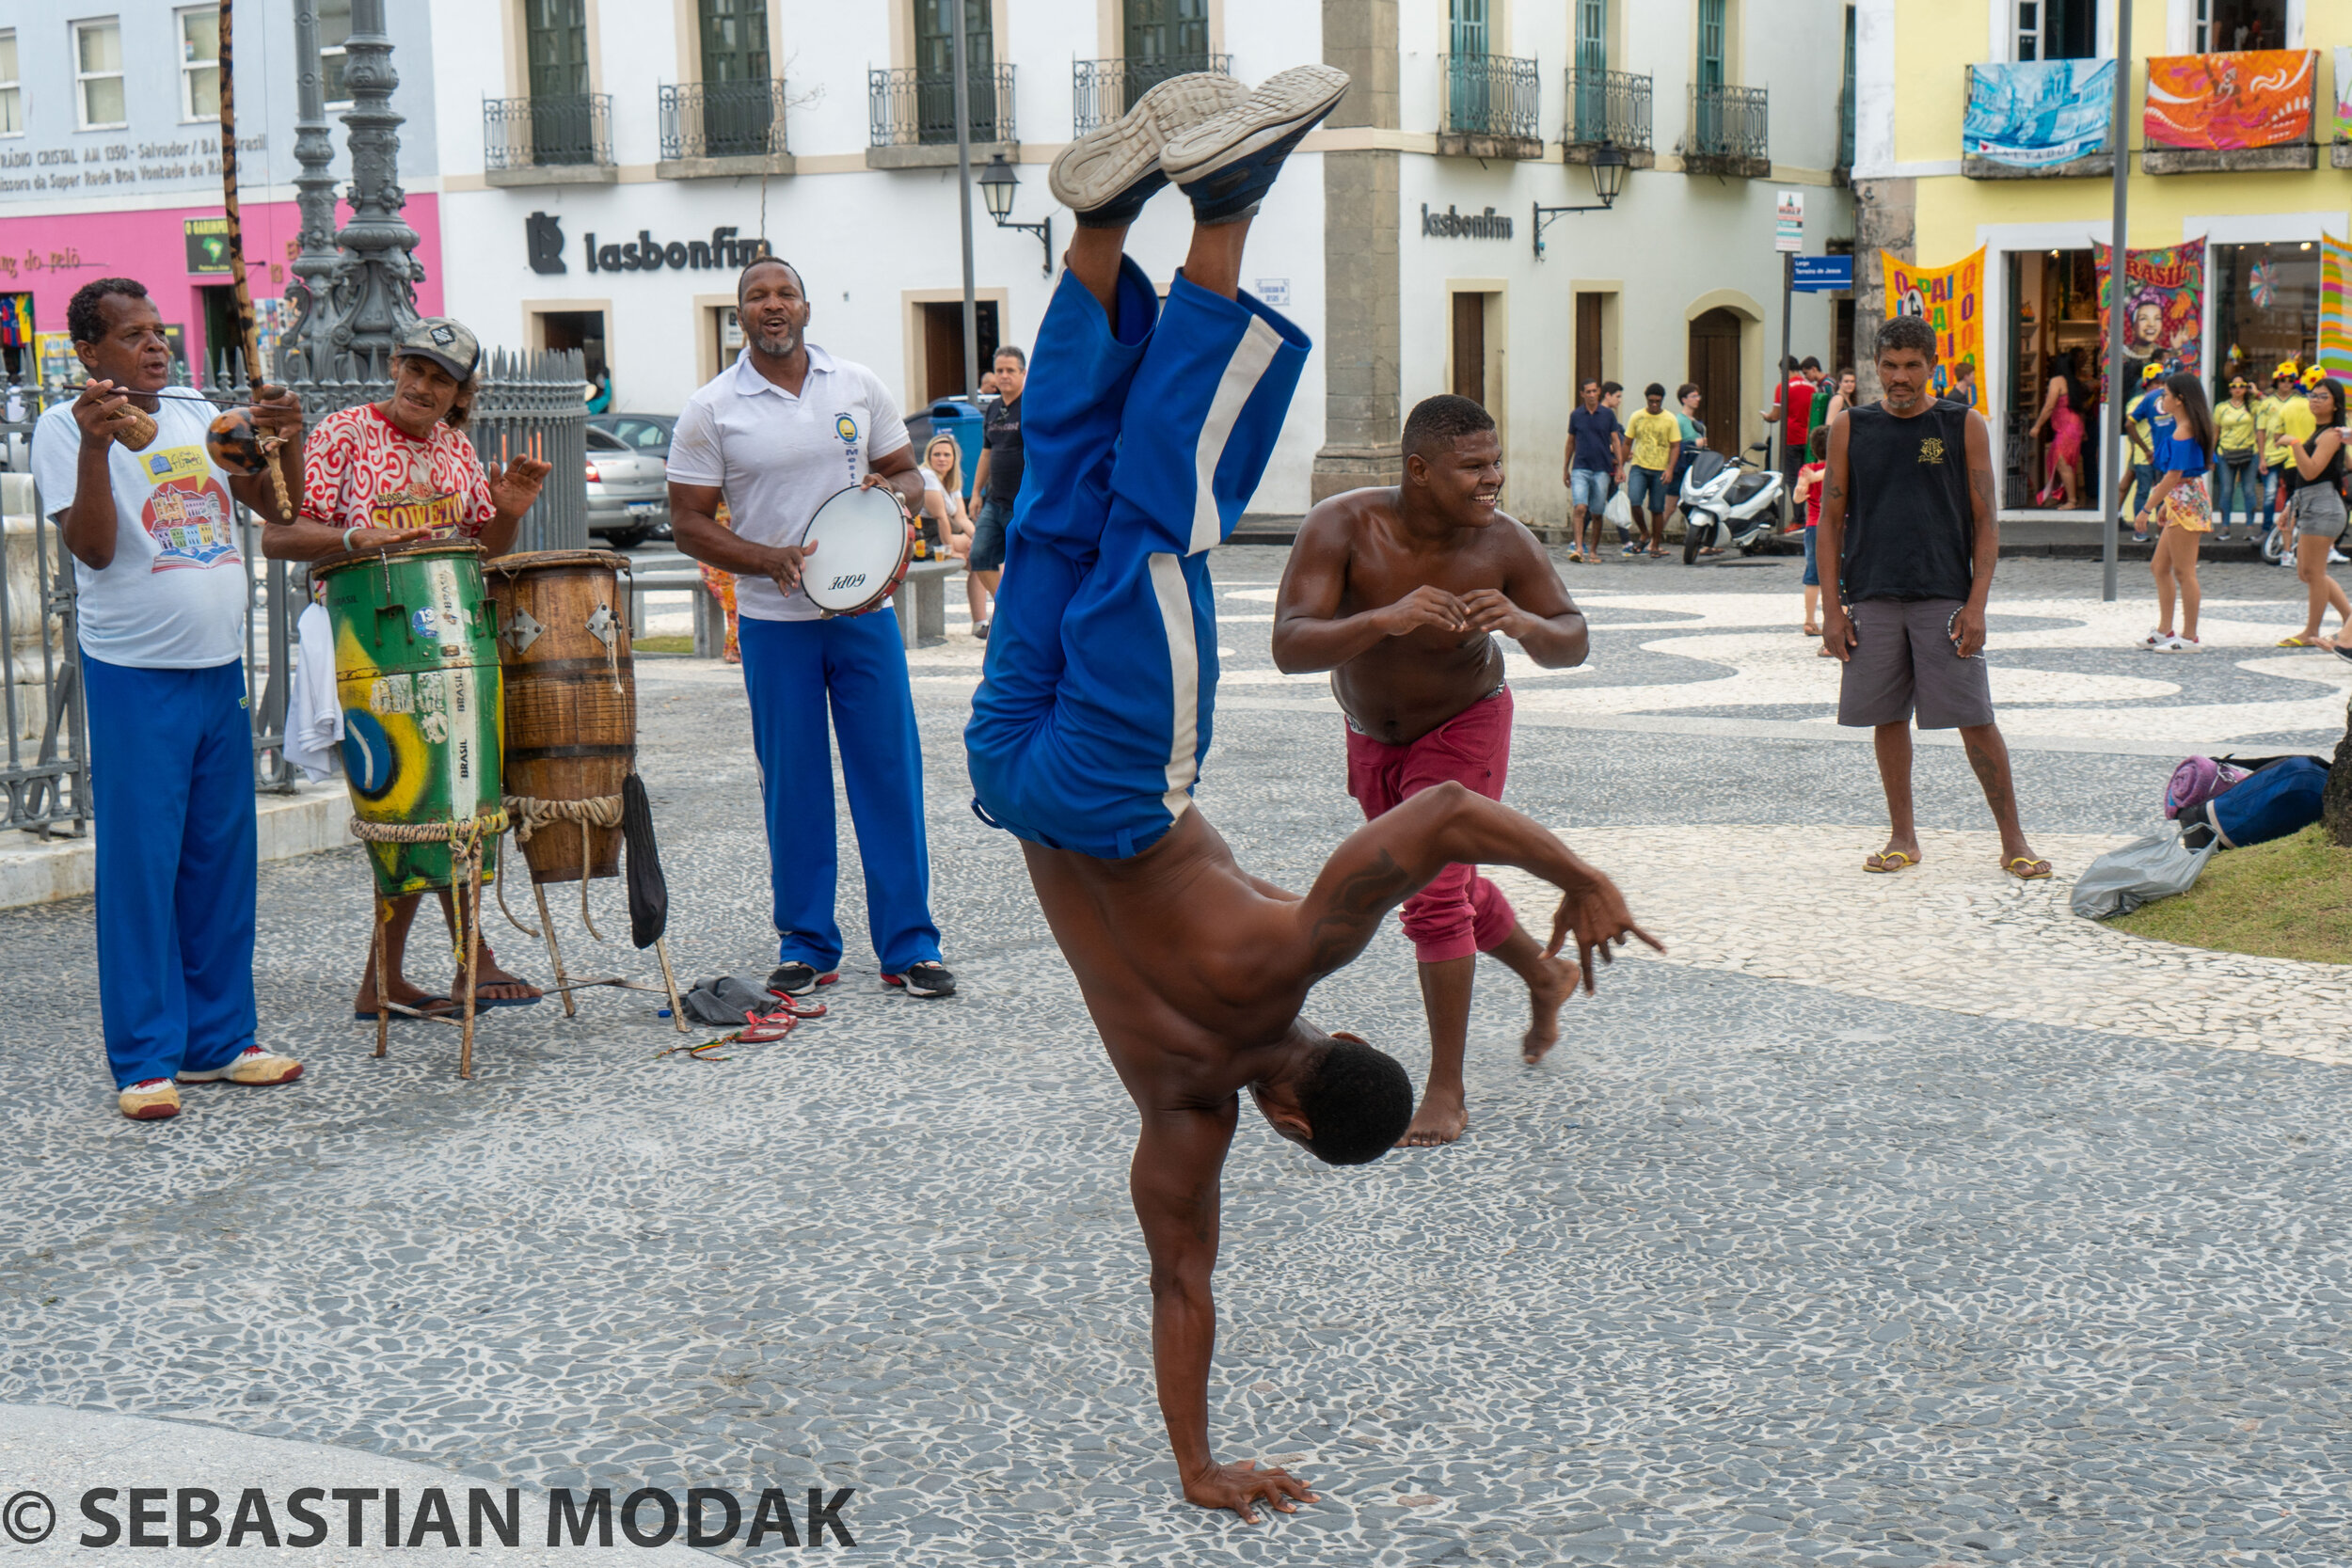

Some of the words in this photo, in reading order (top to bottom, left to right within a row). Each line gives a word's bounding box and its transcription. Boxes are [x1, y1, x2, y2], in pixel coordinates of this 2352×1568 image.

[0, 148, 31, 168] RÁDIO
[38, 149, 78, 166] CRISTAL
[84, 147, 100, 163] AM
[104, 144, 128, 161] 1350
[138, 140, 188, 159] Salvador
[201, 137, 217, 154] BA
[1992, 142, 2076, 160] SALVADOR
[35, 174, 46, 190] da
[50, 172, 80, 192] Super
[85, 170, 111, 186] Rede
[115, 168, 135, 183] Boa
[139, 163, 185, 181] Vontade
[190, 160, 203, 177] de
[1422, 203, 1513, 240] lasbonfim
[24, 248, 40, 271] do
[584, 227, 771, 273] lasbonfim
[2124, 258, 2185, 288] RASIL
[846, 449, 858, 487] Mestr
[372, 492, 463, 531] SOWETO
[378, 492, 403, 503] BLOCO
[827, 573, 866, 591] GOPE
[455, 673, 466, 712] BRASIL
[459, 739, 469, 779] BRASIL
